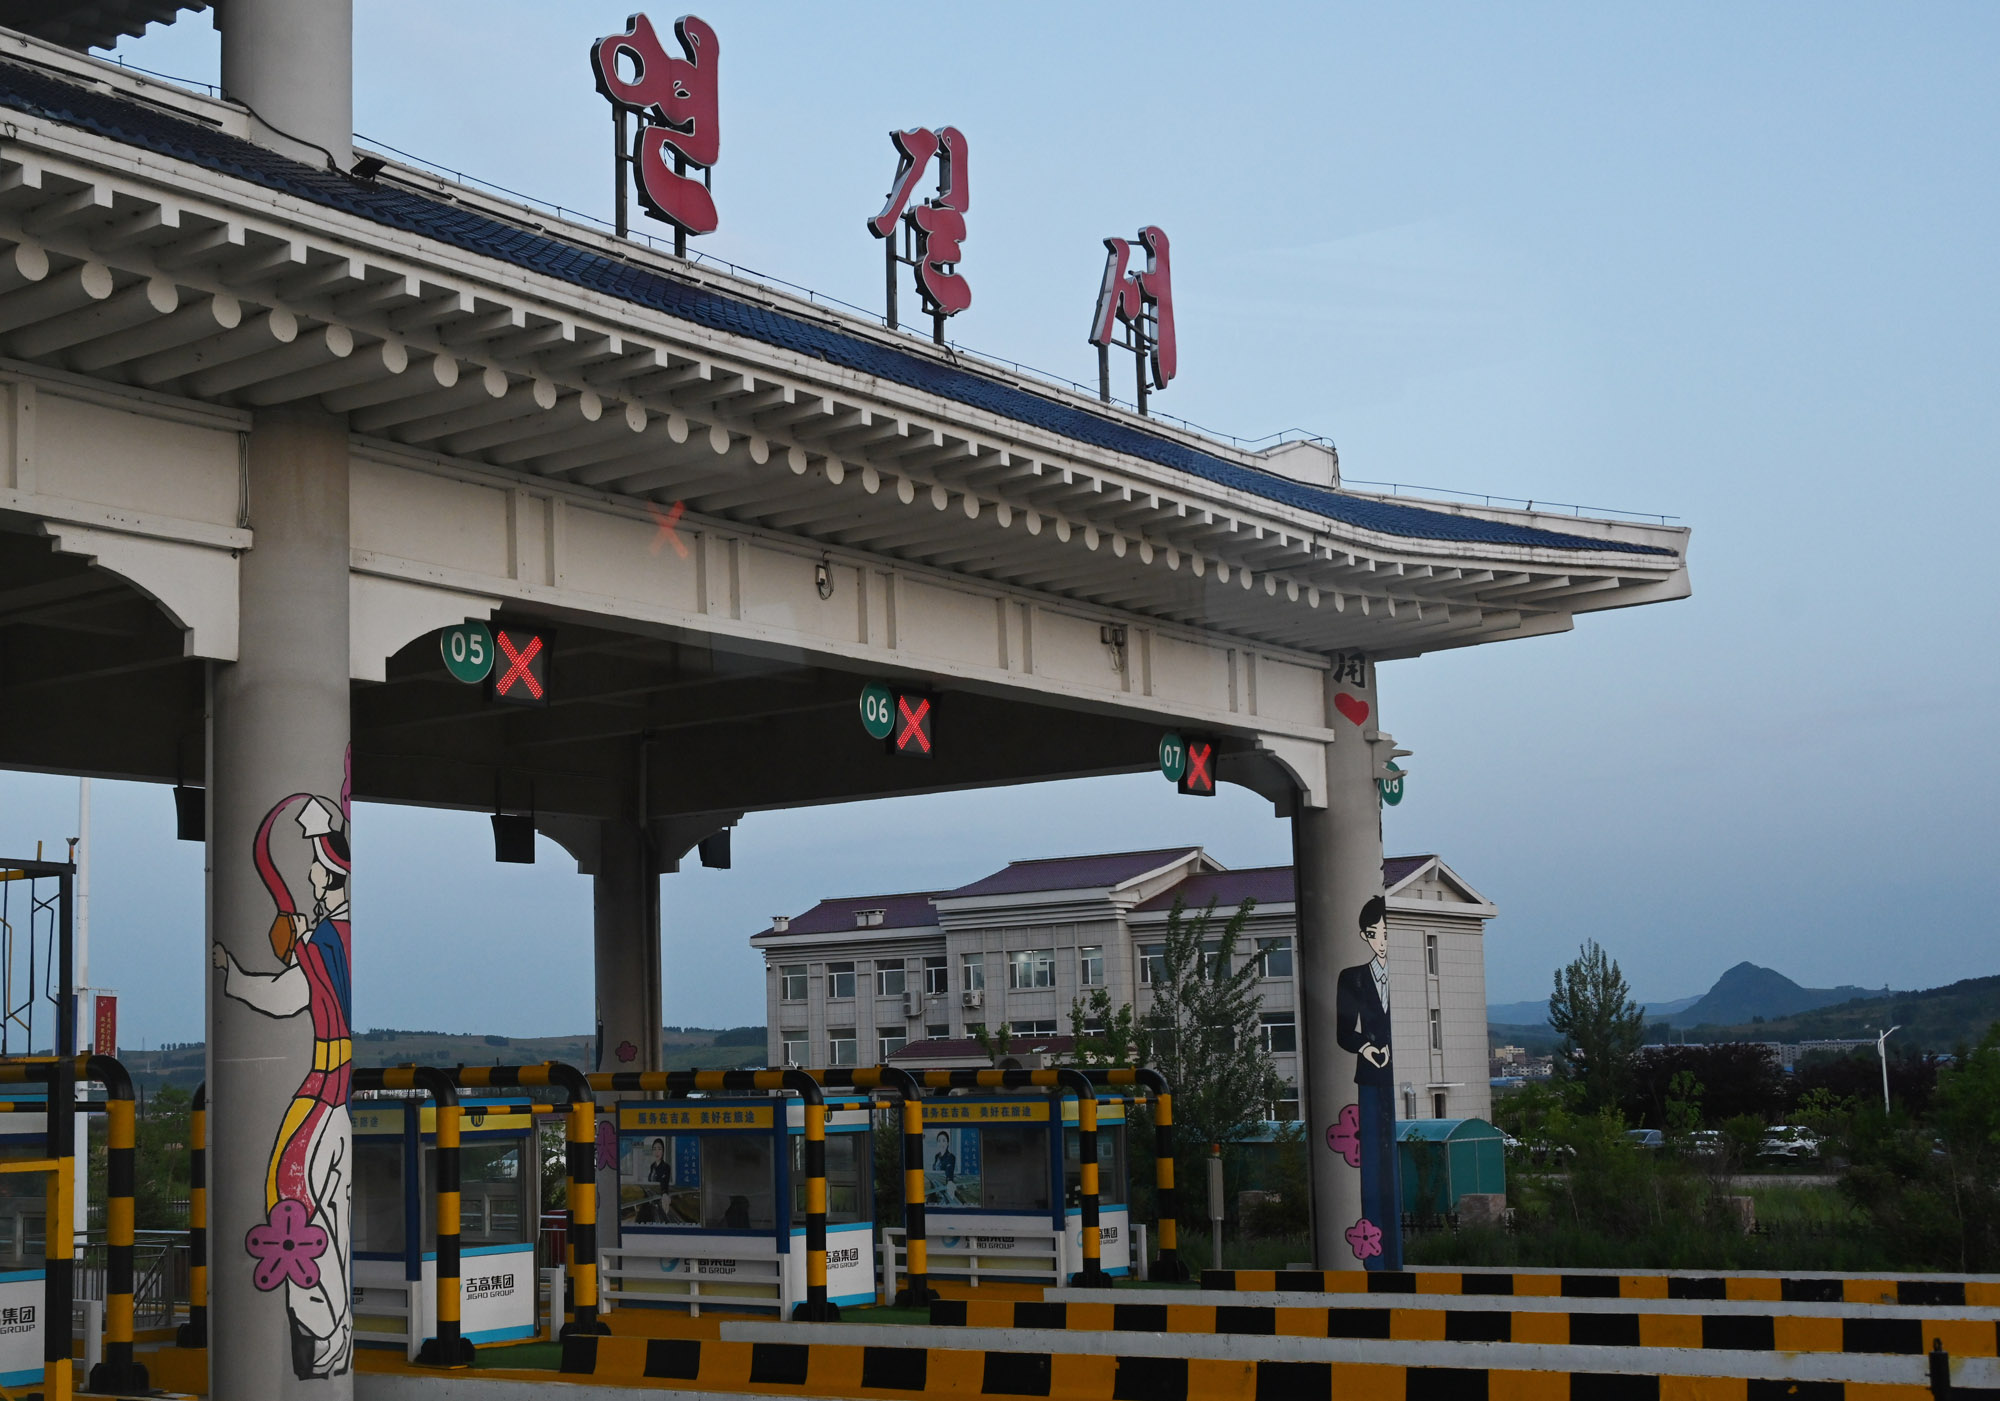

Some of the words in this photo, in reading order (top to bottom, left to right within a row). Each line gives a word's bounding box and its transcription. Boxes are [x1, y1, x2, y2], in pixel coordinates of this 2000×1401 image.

[451, 631, 484, 665] 05
[867, 695, 888, 723] 06
[1164, 745, 1181, 768] 07
[638, 1112, 690, 1125] 服务在吉高
[701, 1111, 755, 1124] 美好在旅途
[466, 1273, 514, 1293] 吉高集团
[466, 1291, 489, 1301] JIGAO
[489, 1288, 515, 1299] GROUP
[0, 1324, 36, 1335] GROUP
